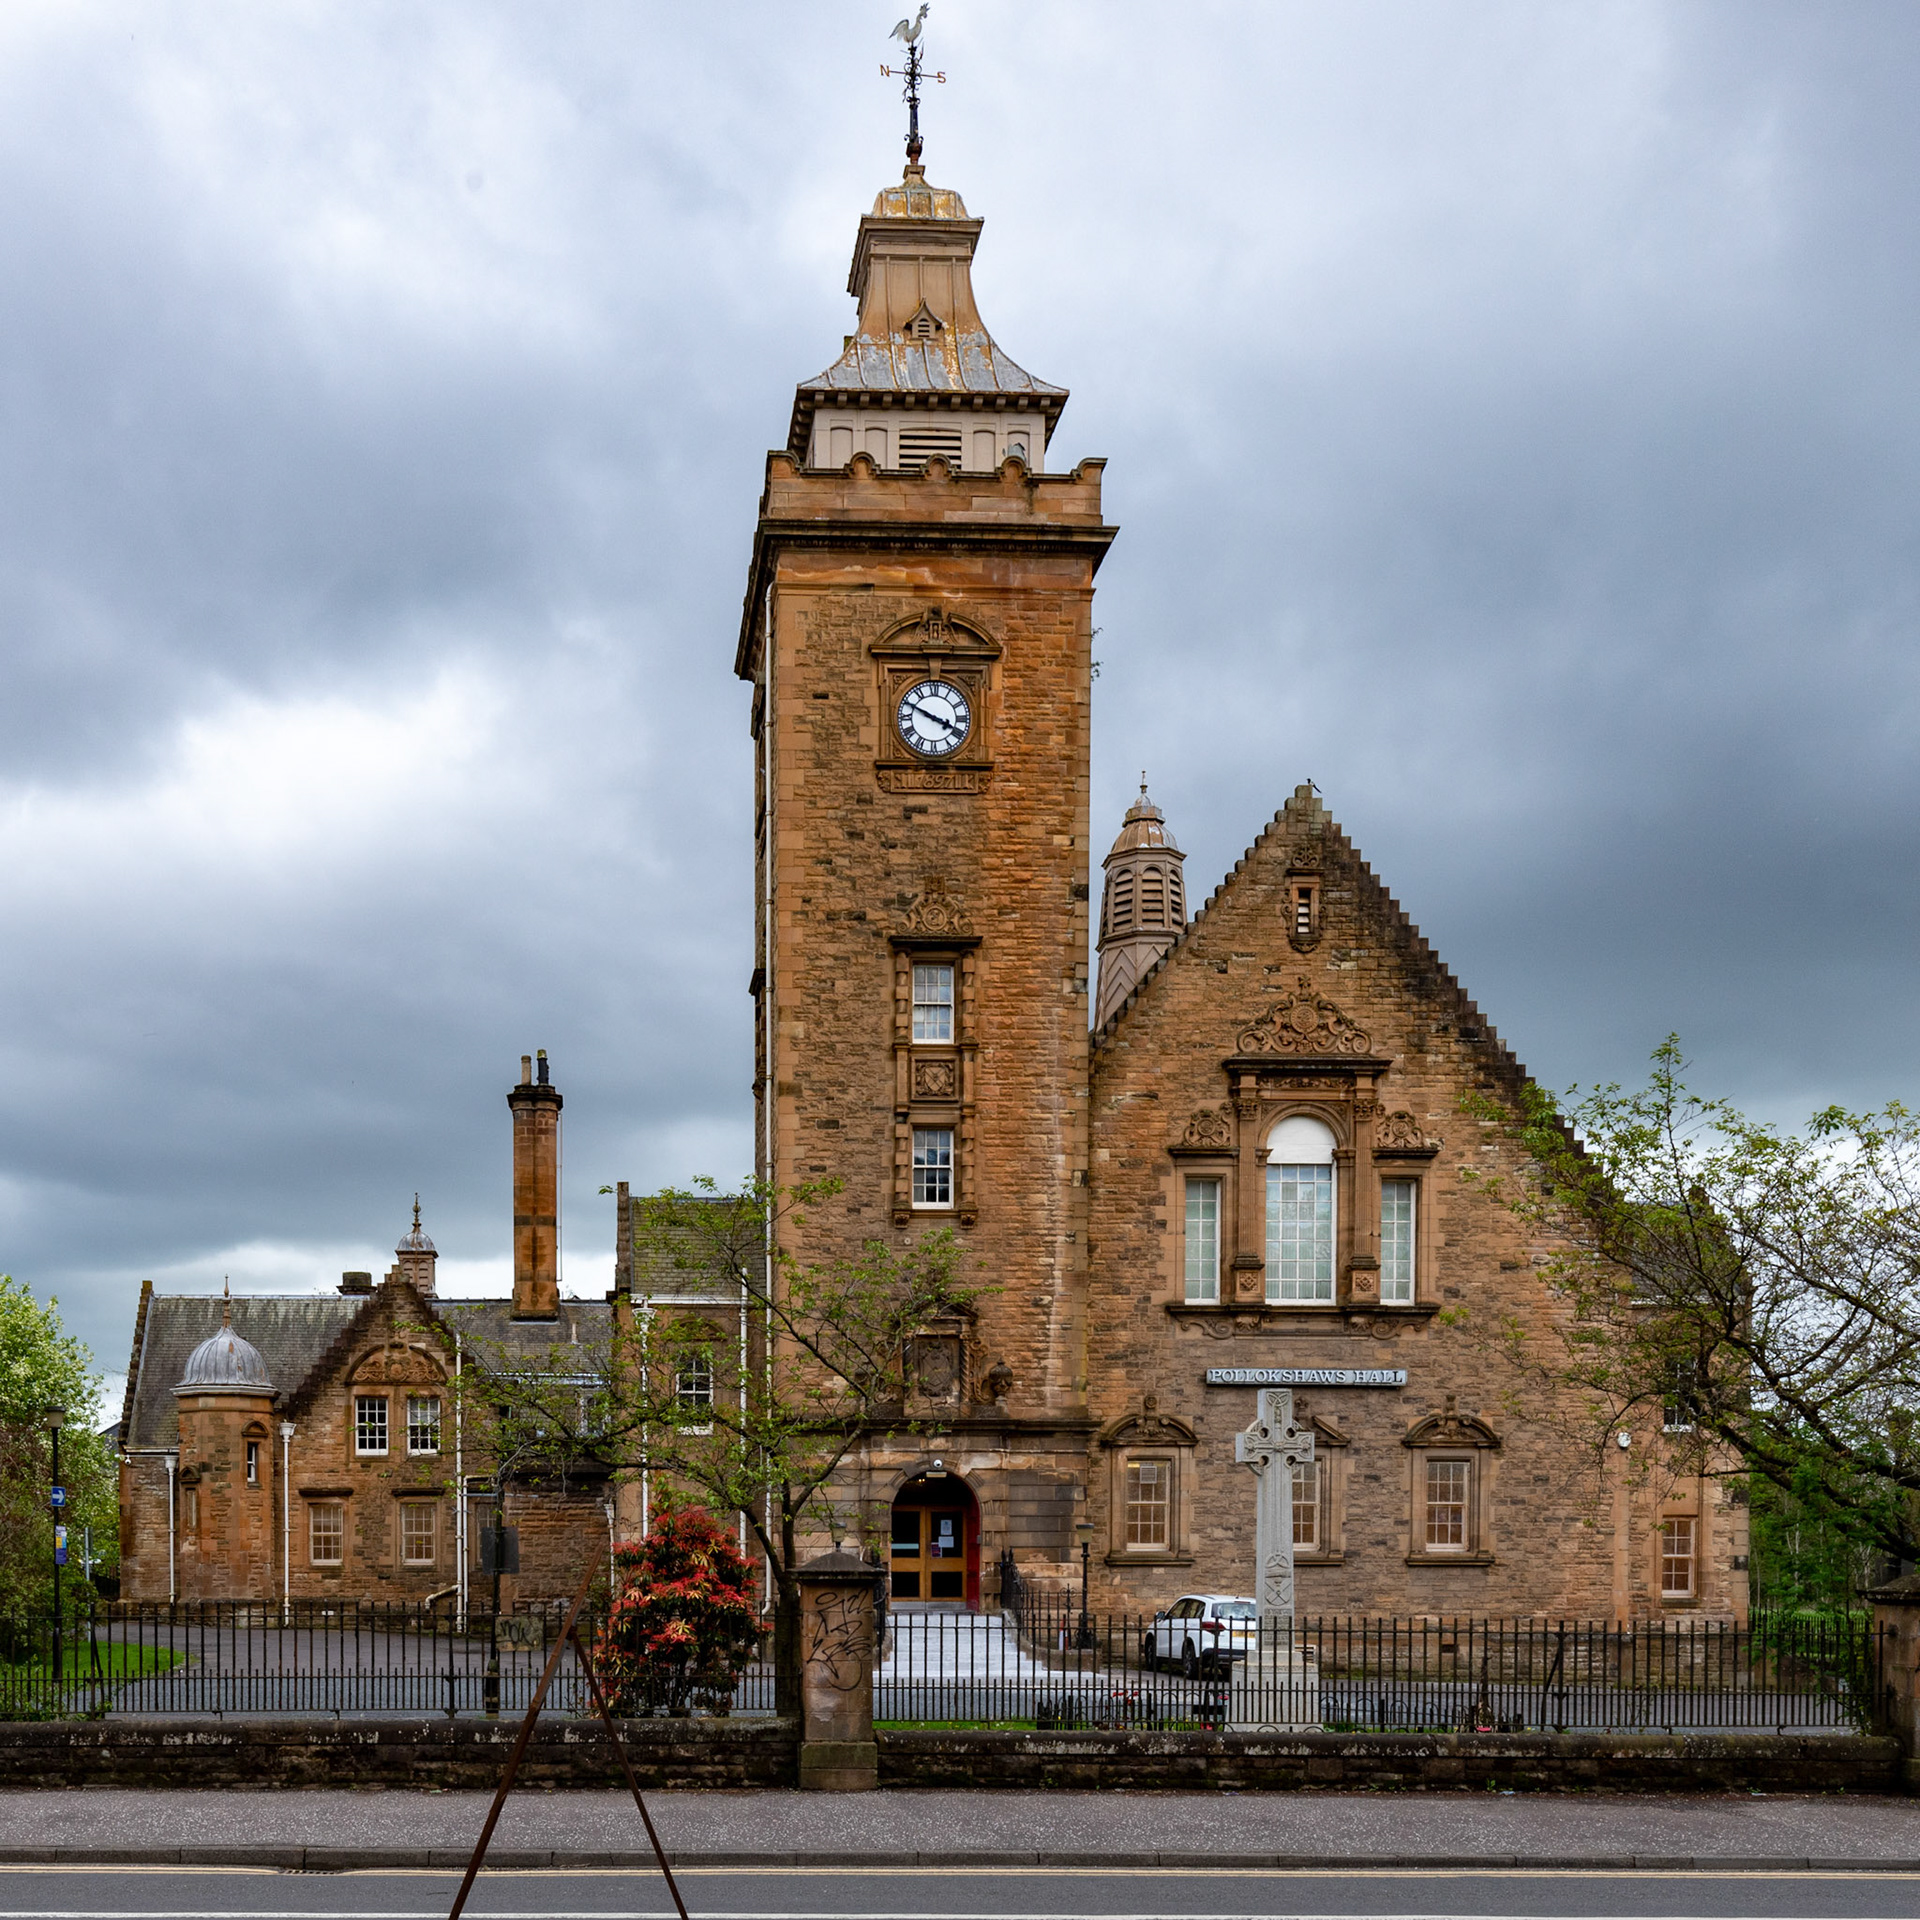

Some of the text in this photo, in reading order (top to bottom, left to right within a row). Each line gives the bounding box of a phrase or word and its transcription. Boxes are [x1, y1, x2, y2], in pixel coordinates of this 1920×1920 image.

[880, 64, 889, 77] N
[937, 71, 946, 83] S
[1210, 1369, 1403, 1383] POLLOKSHAWS HALL
